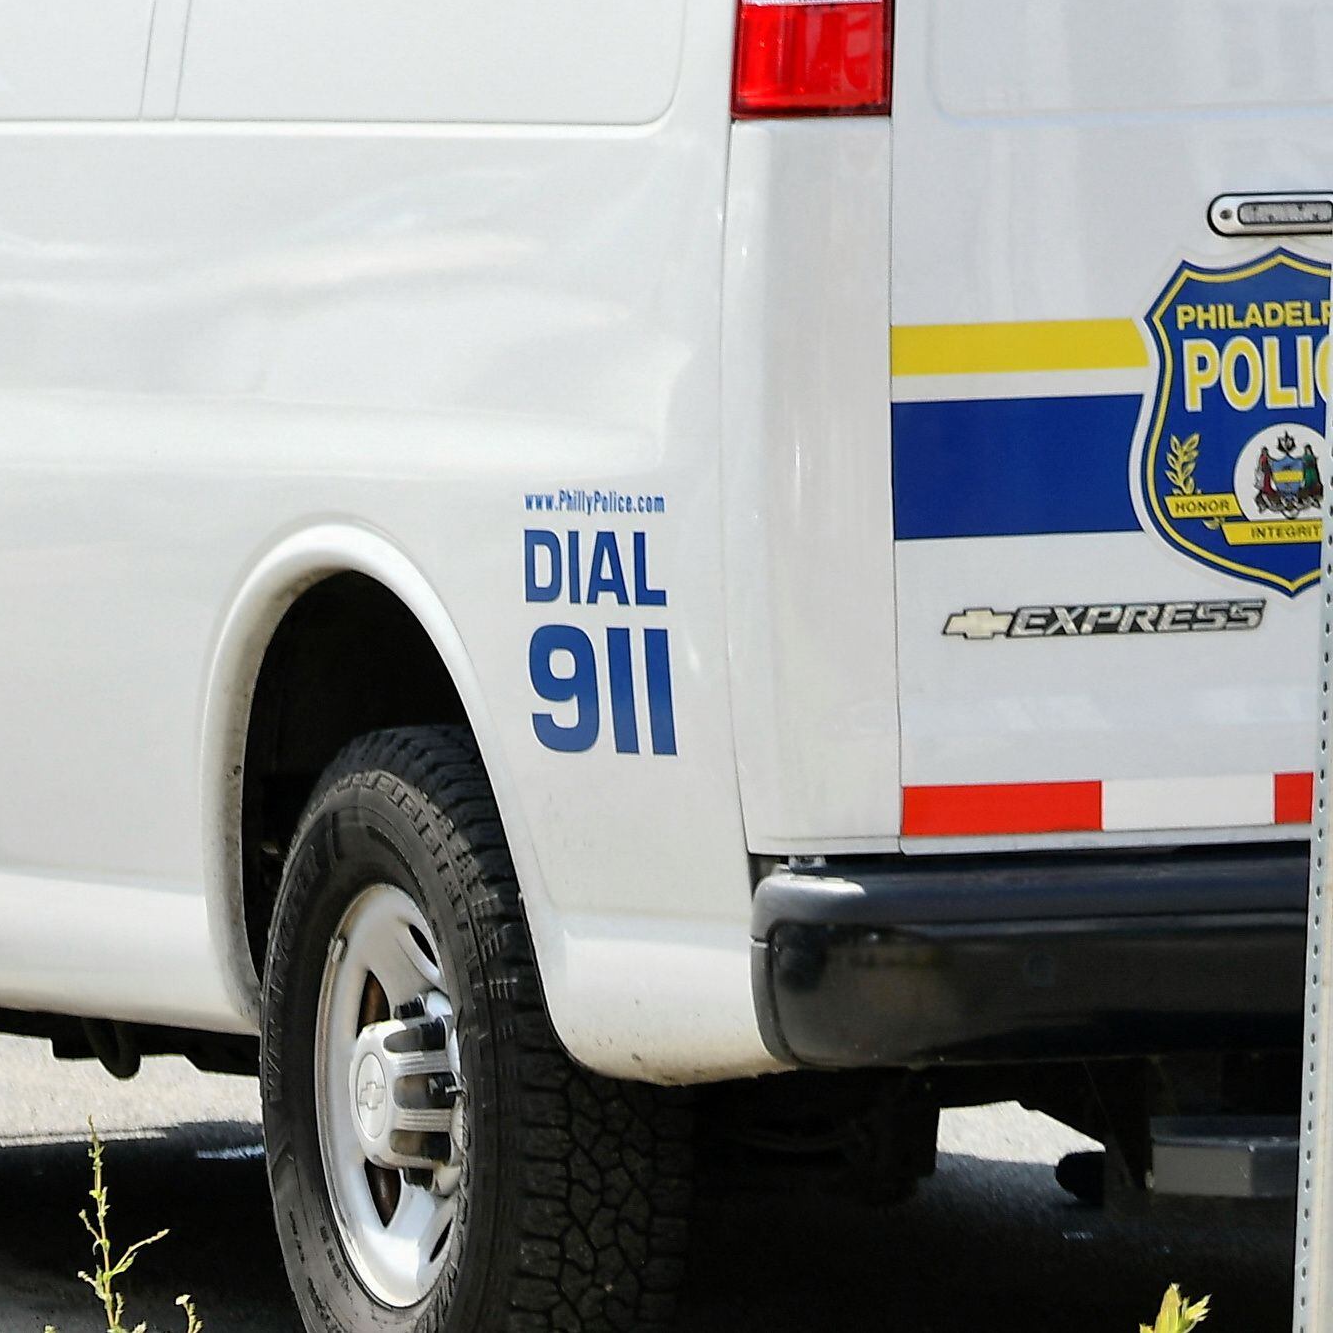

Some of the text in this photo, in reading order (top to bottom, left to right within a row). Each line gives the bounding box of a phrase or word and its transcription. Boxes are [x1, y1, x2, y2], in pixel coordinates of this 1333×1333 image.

[523, 490, 665, 515] www.PhillyPolice.com
[1174, 500, 1231, 514] HONOR
[523, 529, 668, 607] DIAL
[1007, 600, 1267, 638] EXPRESS
[528, 623, 678, 756] 911
